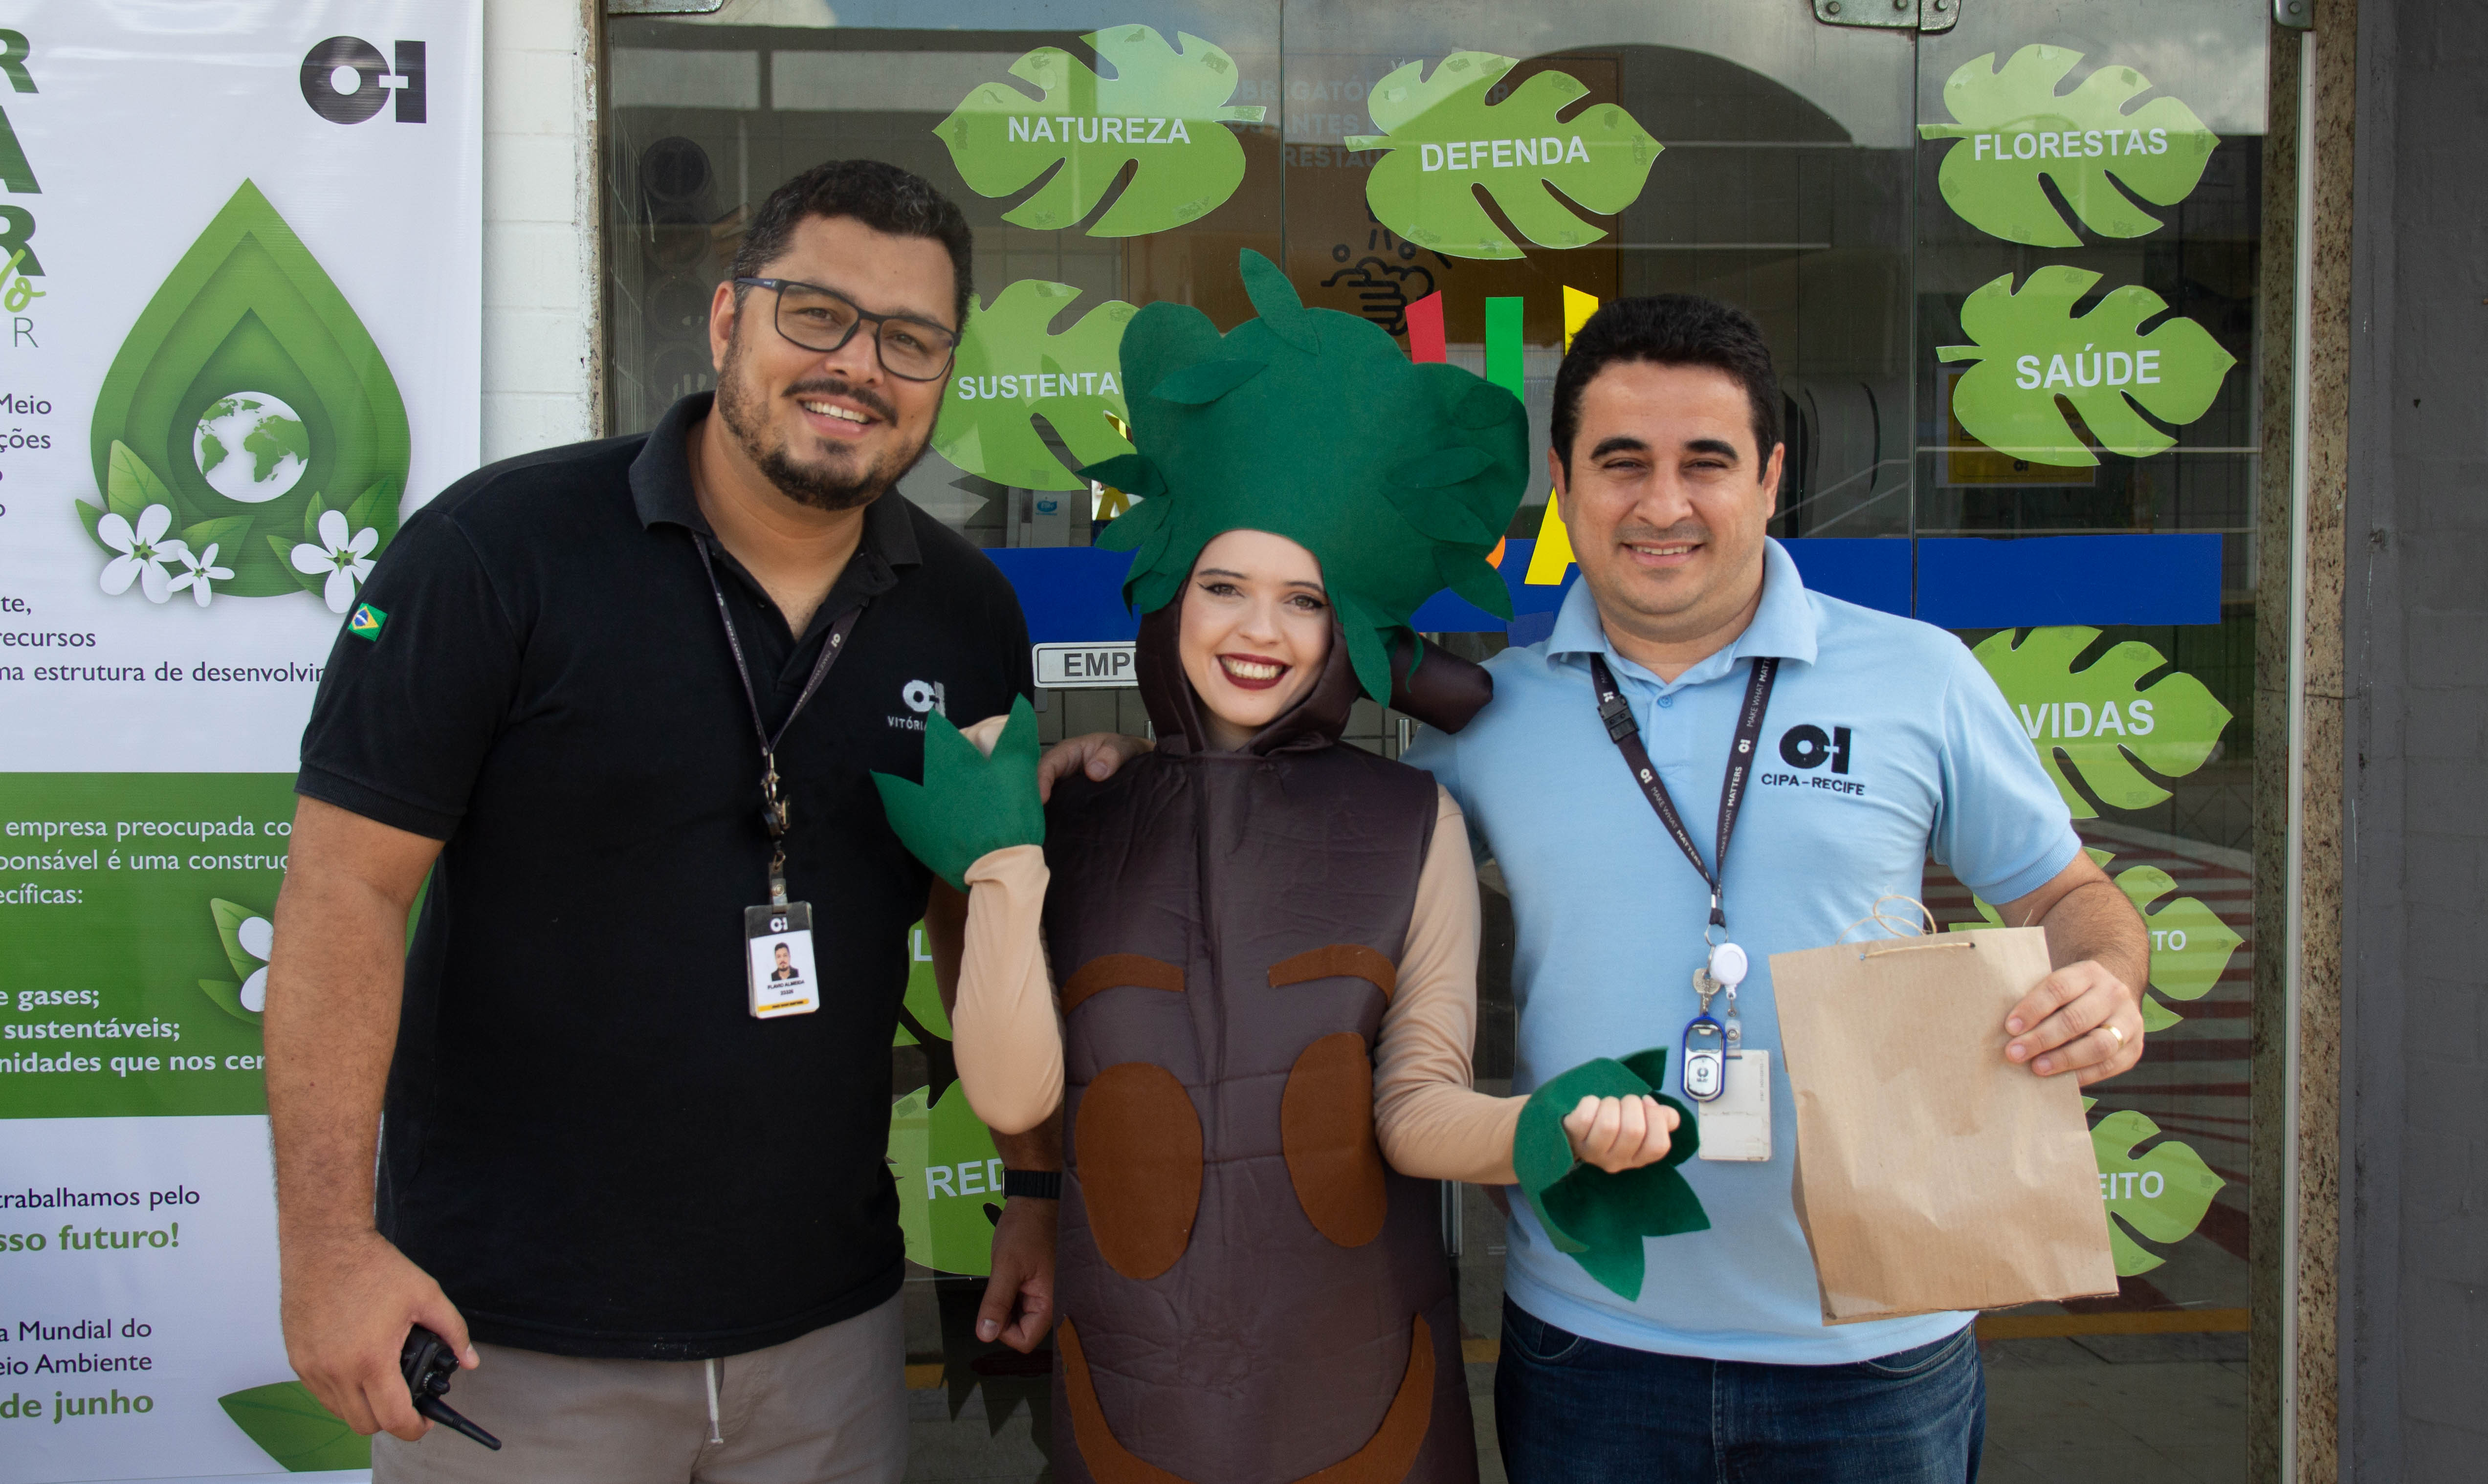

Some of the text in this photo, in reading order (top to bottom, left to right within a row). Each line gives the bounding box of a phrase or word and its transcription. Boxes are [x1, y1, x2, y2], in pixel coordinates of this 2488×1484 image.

[1009, 117, 1190, 144] NATUREZA
[1421, 136, 1590, 171] DEFENDA
[1974, 128, 2168, 161] FLORESTAS
[2016, 344, 2160, 390] SAÚDE
[958, 372, 1122, 400] SUSTENTA
[1, 596, 32, 615] te,
[0, 633, 96, 647] ecursos
[34, 664, 145, 681] estrutura
[155, 661, 183, 681] de
[1064, 652, 1137, 677] EMP
[1752, 683, 1764, 706] WHAT
[1746, 707, 1759, 727] MAKE
[2020, 699, 2155, 739] VIDAS
[1727, 766, 1743, 807] MATTERS
[6, 822, 108, 842] empresa
[117, 815, 255, 841] preocupada
[1651, 786, 1665, 808] MAKE
[1663, 806, 1678, 829] WHAT
[1676, 829, 1702, 866] MATTERS
[1723, 809, 1732, 834] WHAT
[108, 850, 121, 870] é
[131, 855, 180, 870] uma
[2148, 930, 2186, 951] TO
[18, 990, 100, 1011] gases;
[4, 1018, 180, 1041] sustentáveis;
[110, 1054, 160, 1077] que
[170, 1054, 216, 1070] nos
[150, 1185, 200, 1211] pelo
[59, 1222, 179, 1250] futuro!
[20, 1319, 111, 1341] Mundial
[122, 1318, 152, 1338] do
[35, 1353, 152, 1375] Ambiente
[0, 1389, 154, 1424] de junho
